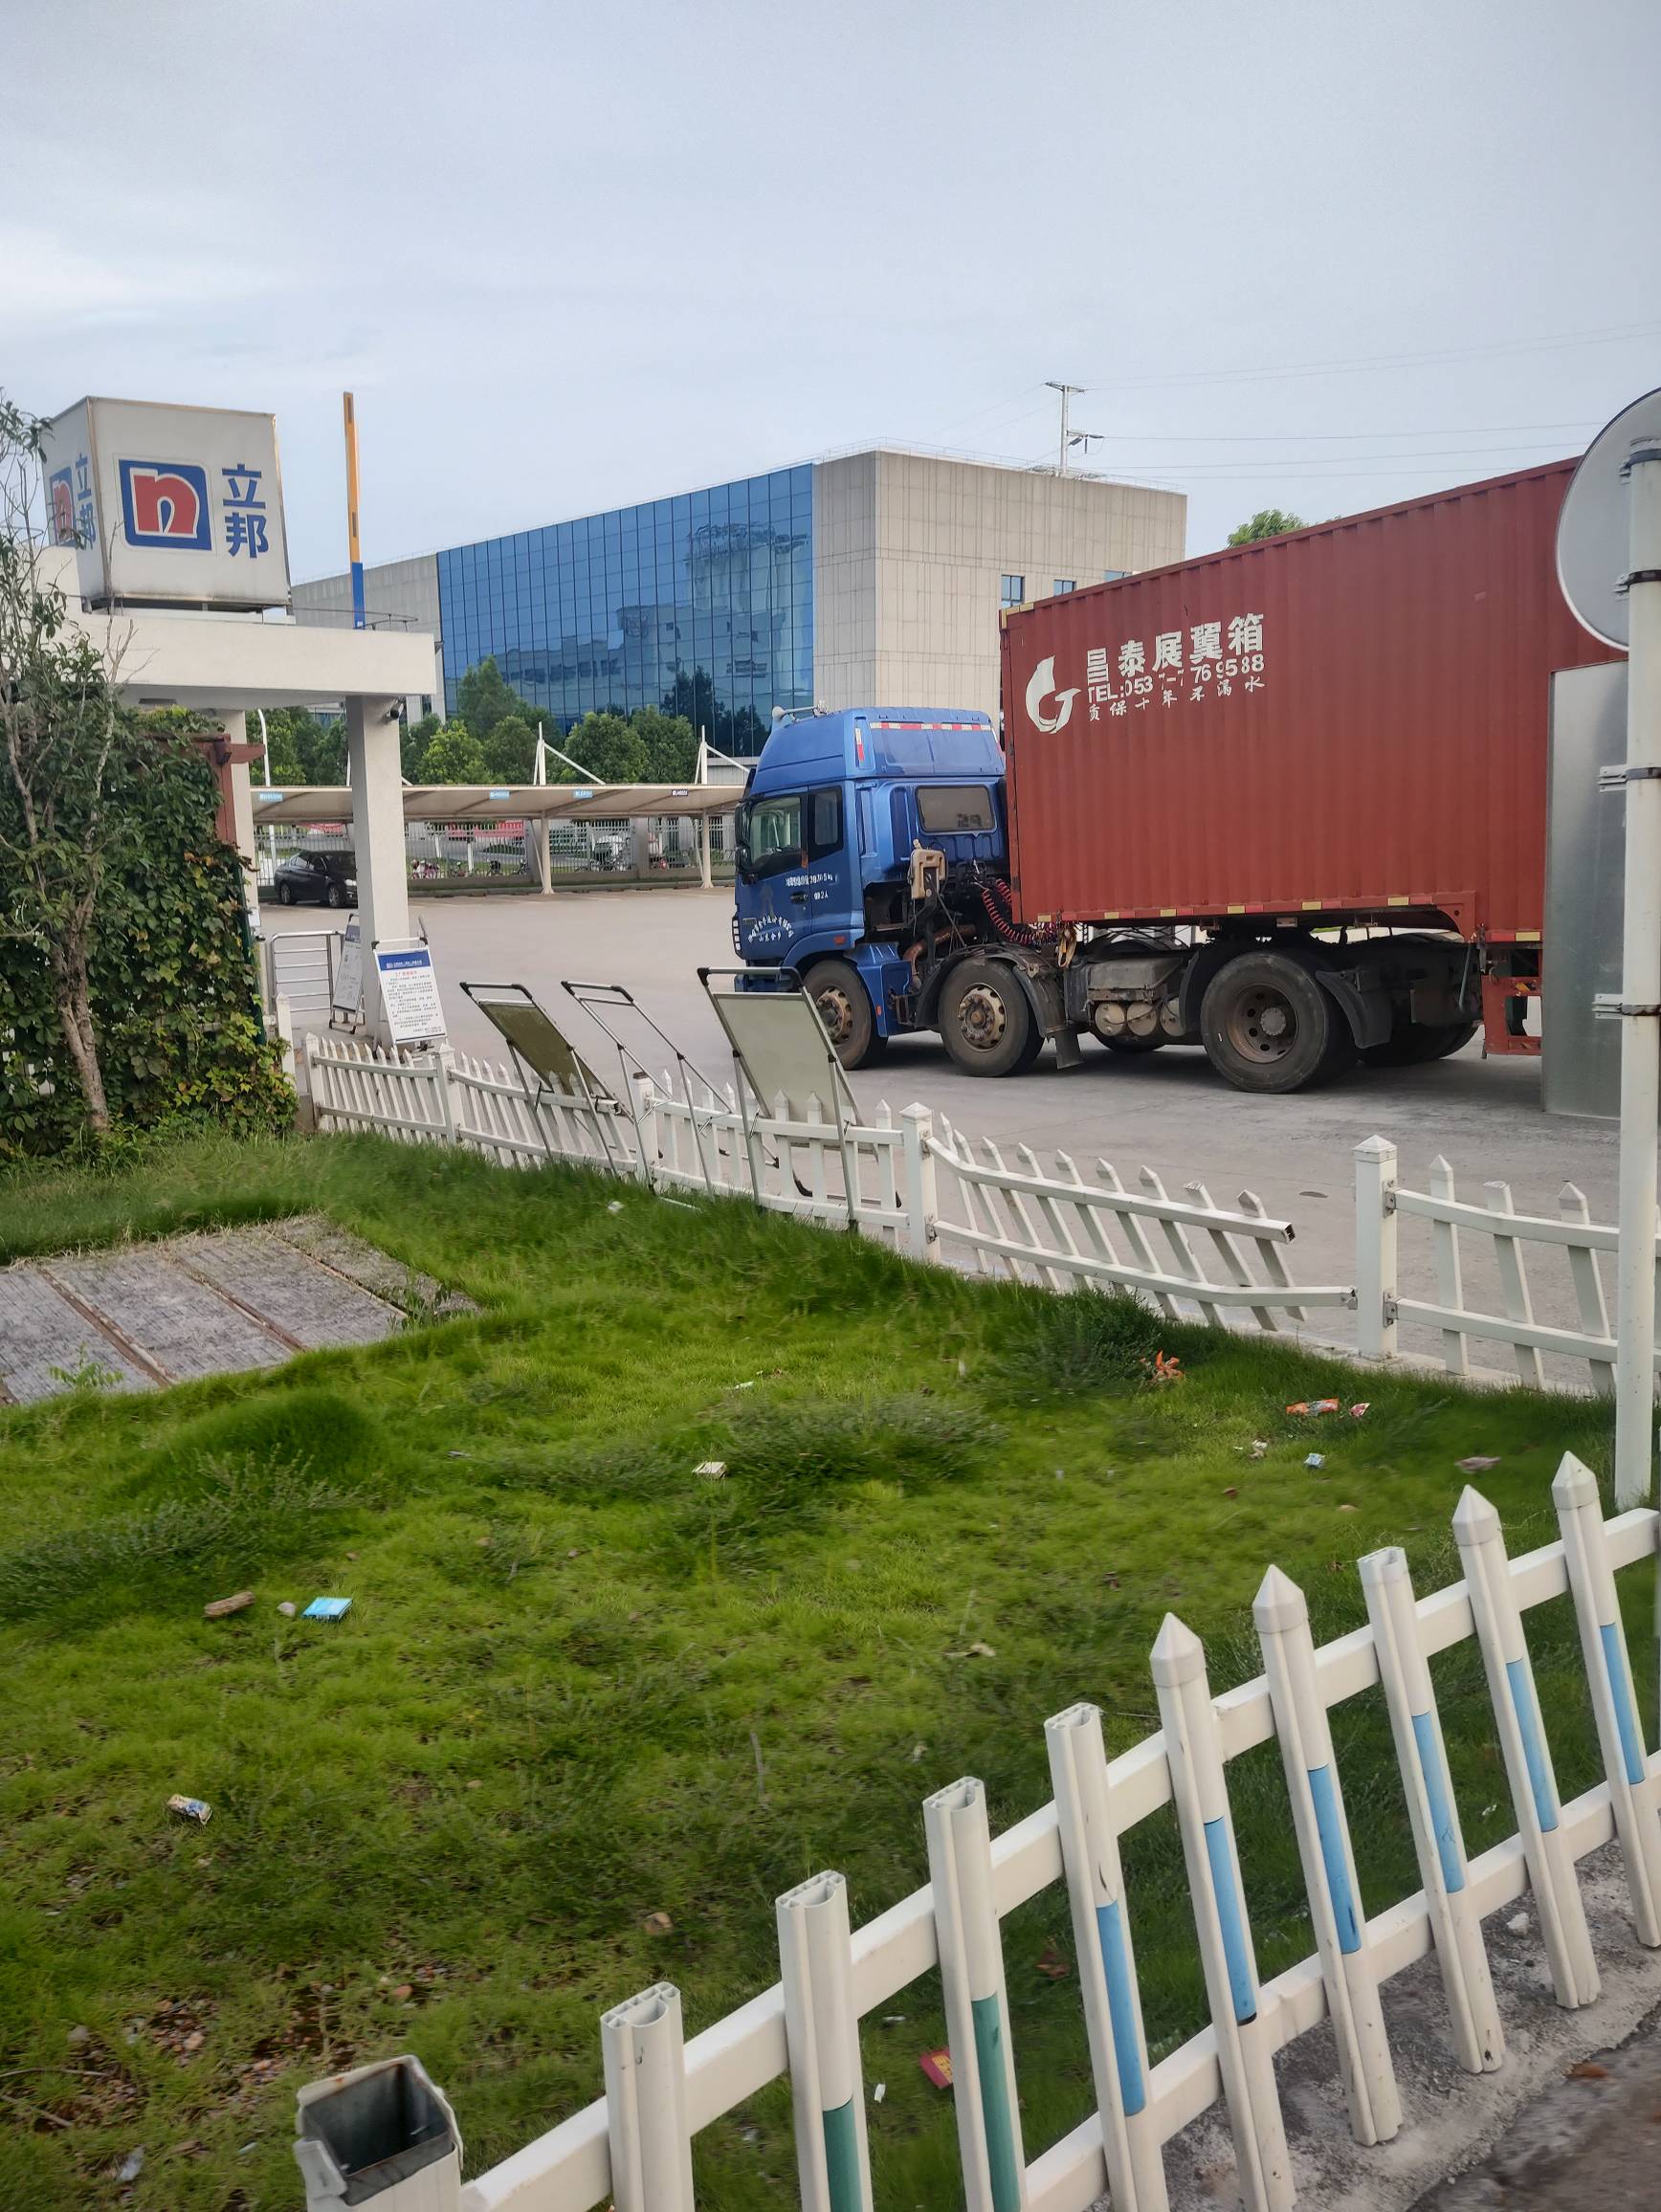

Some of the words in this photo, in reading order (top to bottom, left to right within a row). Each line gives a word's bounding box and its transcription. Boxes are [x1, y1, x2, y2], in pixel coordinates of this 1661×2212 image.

[222, 463, 269, 558] 立邦
[1087, 613, 1264, 683] 昌泰展翼箱
